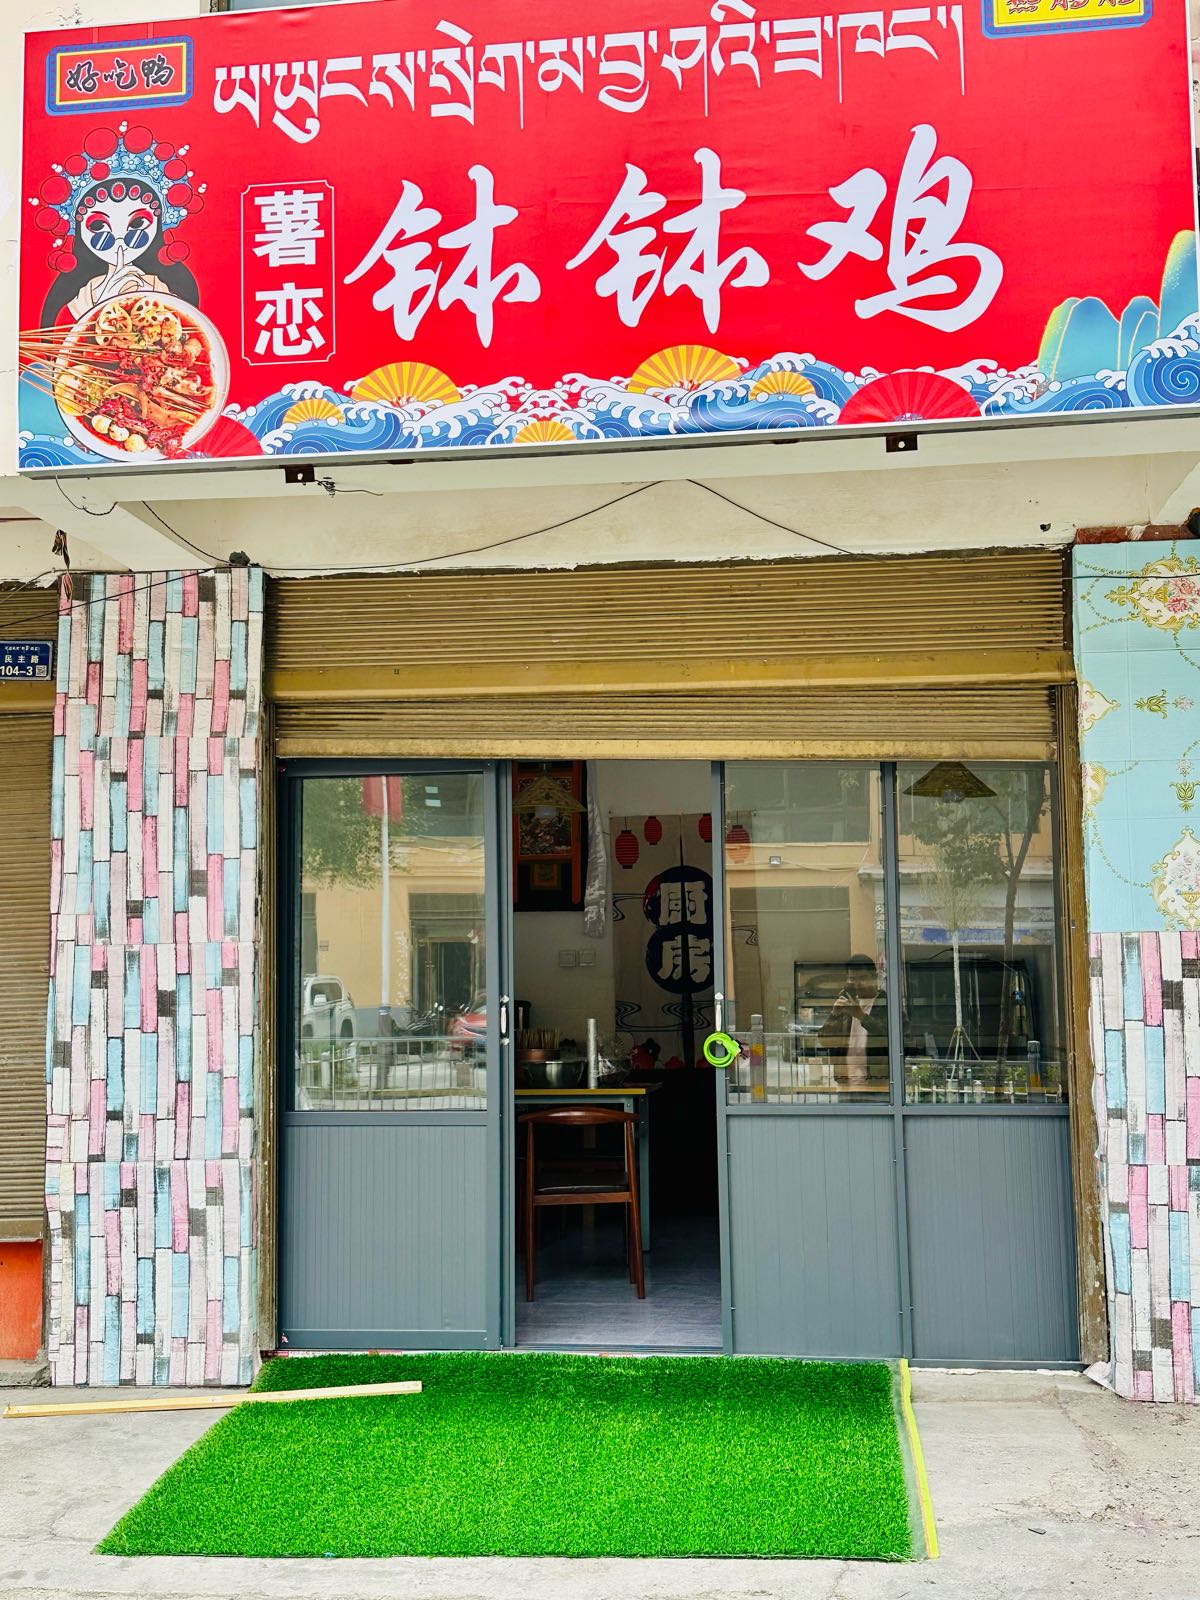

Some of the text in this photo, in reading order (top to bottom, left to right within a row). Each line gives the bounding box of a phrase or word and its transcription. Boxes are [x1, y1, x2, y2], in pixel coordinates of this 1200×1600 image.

[66, 53, 175, 94] 好吃鸭
[252, 189, 326, 357] 薯恋
[343, 123, 1004, 349] 钵钵鸡
[4, 654, 39, 664] 民主路
